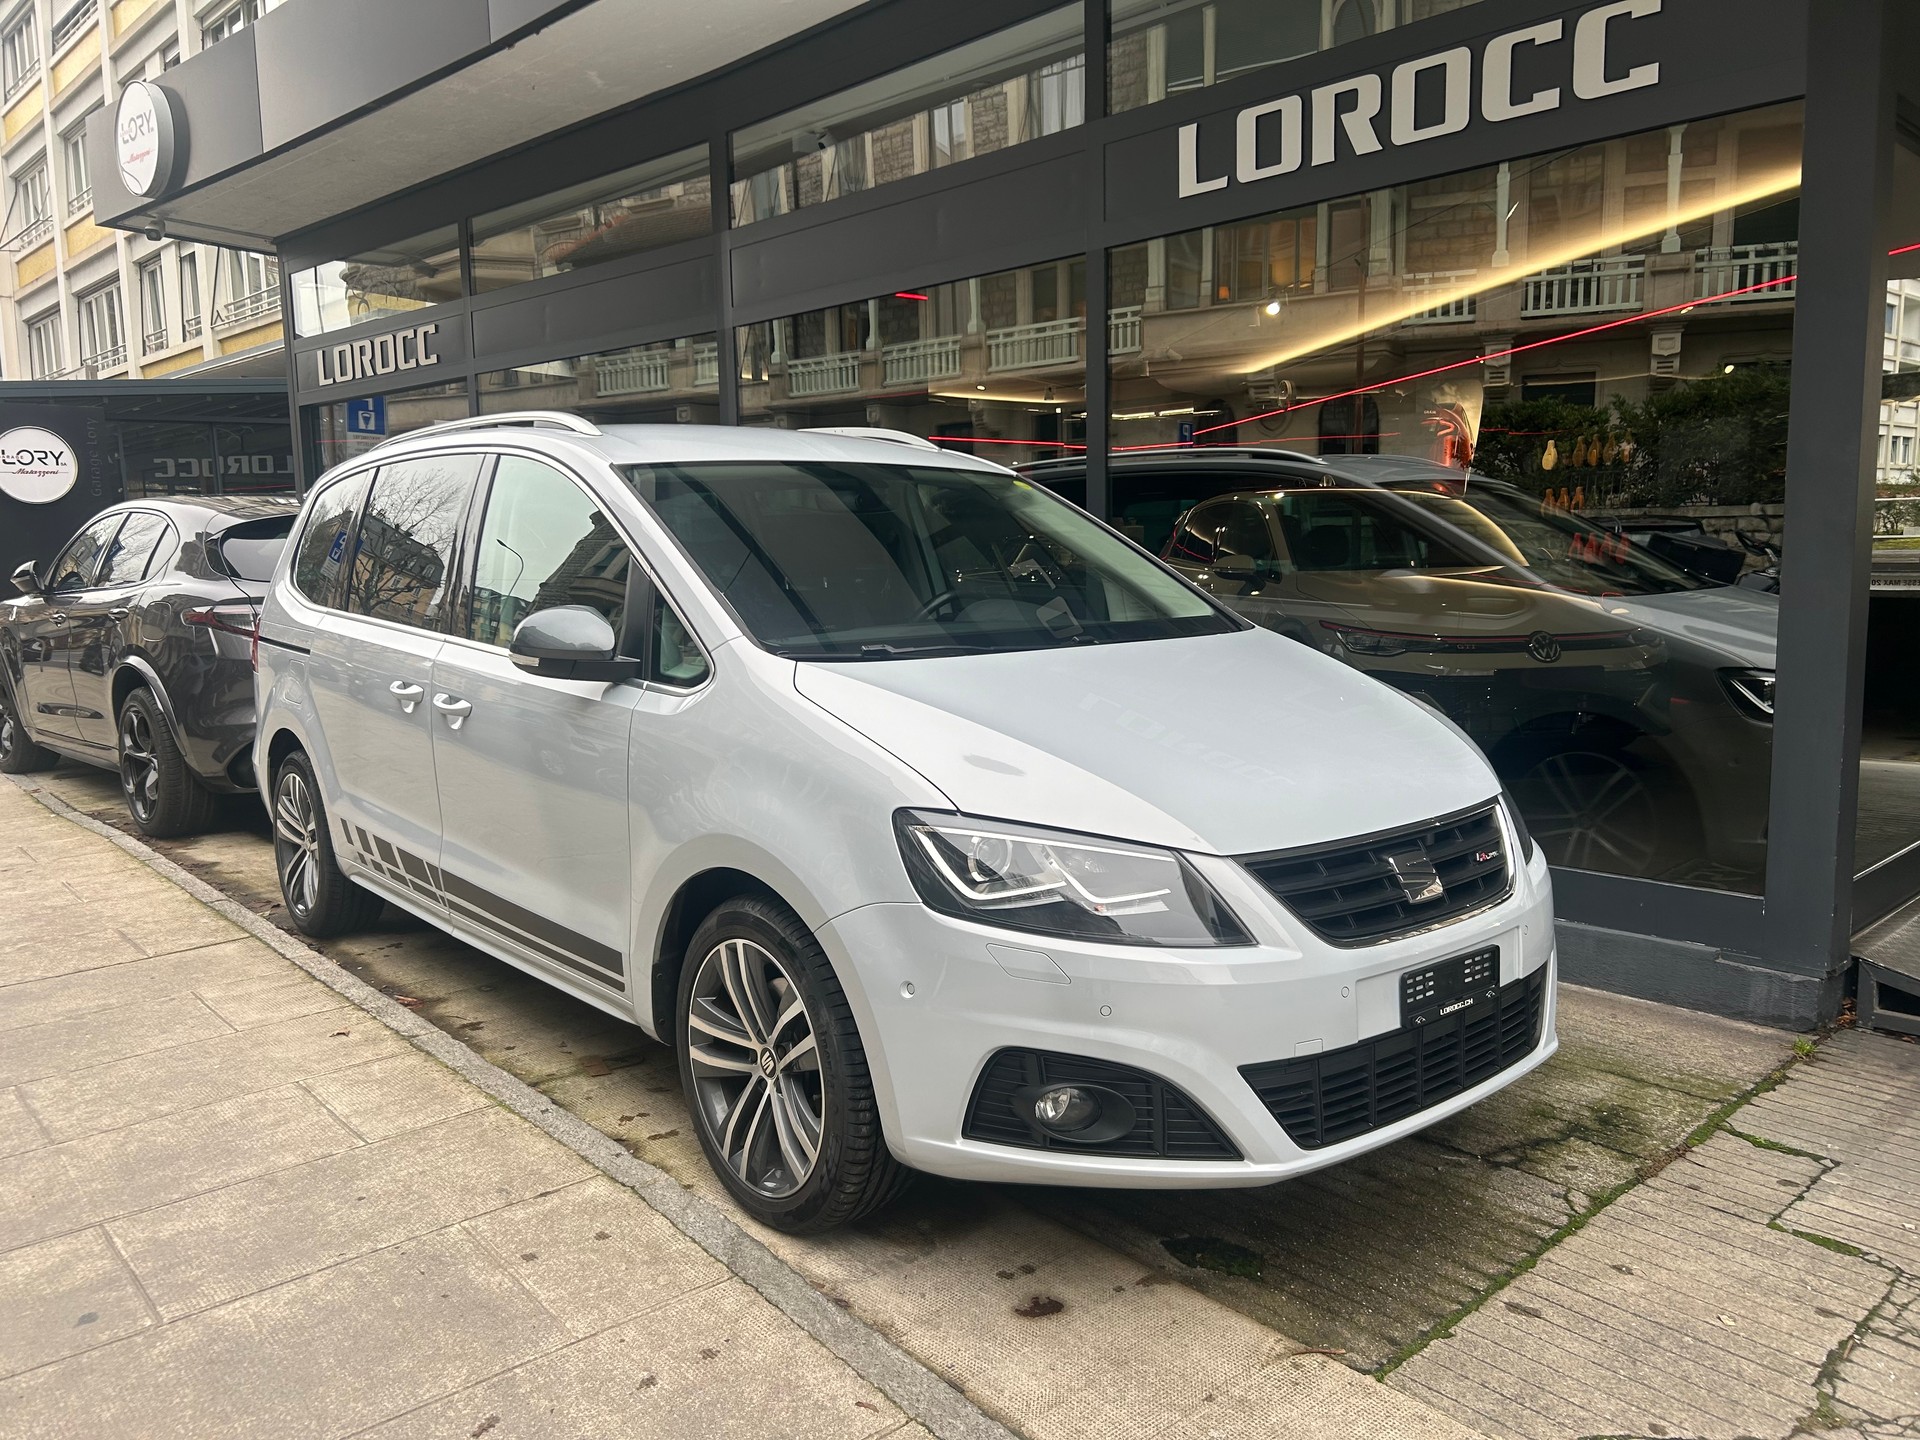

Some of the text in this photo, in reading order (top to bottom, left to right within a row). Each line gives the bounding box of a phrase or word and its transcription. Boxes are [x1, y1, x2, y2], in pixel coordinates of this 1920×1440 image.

[1178, 0, 1661, 199] LOROCC
[316, 324, 438, 387] LOROCC
[86, 418, 99, 445] Lory
[1, 449, 64, 467] LORY
[90, 451, 102, 497] Garage
[1439, 997, 1474, 1016] LOROCC.CH
